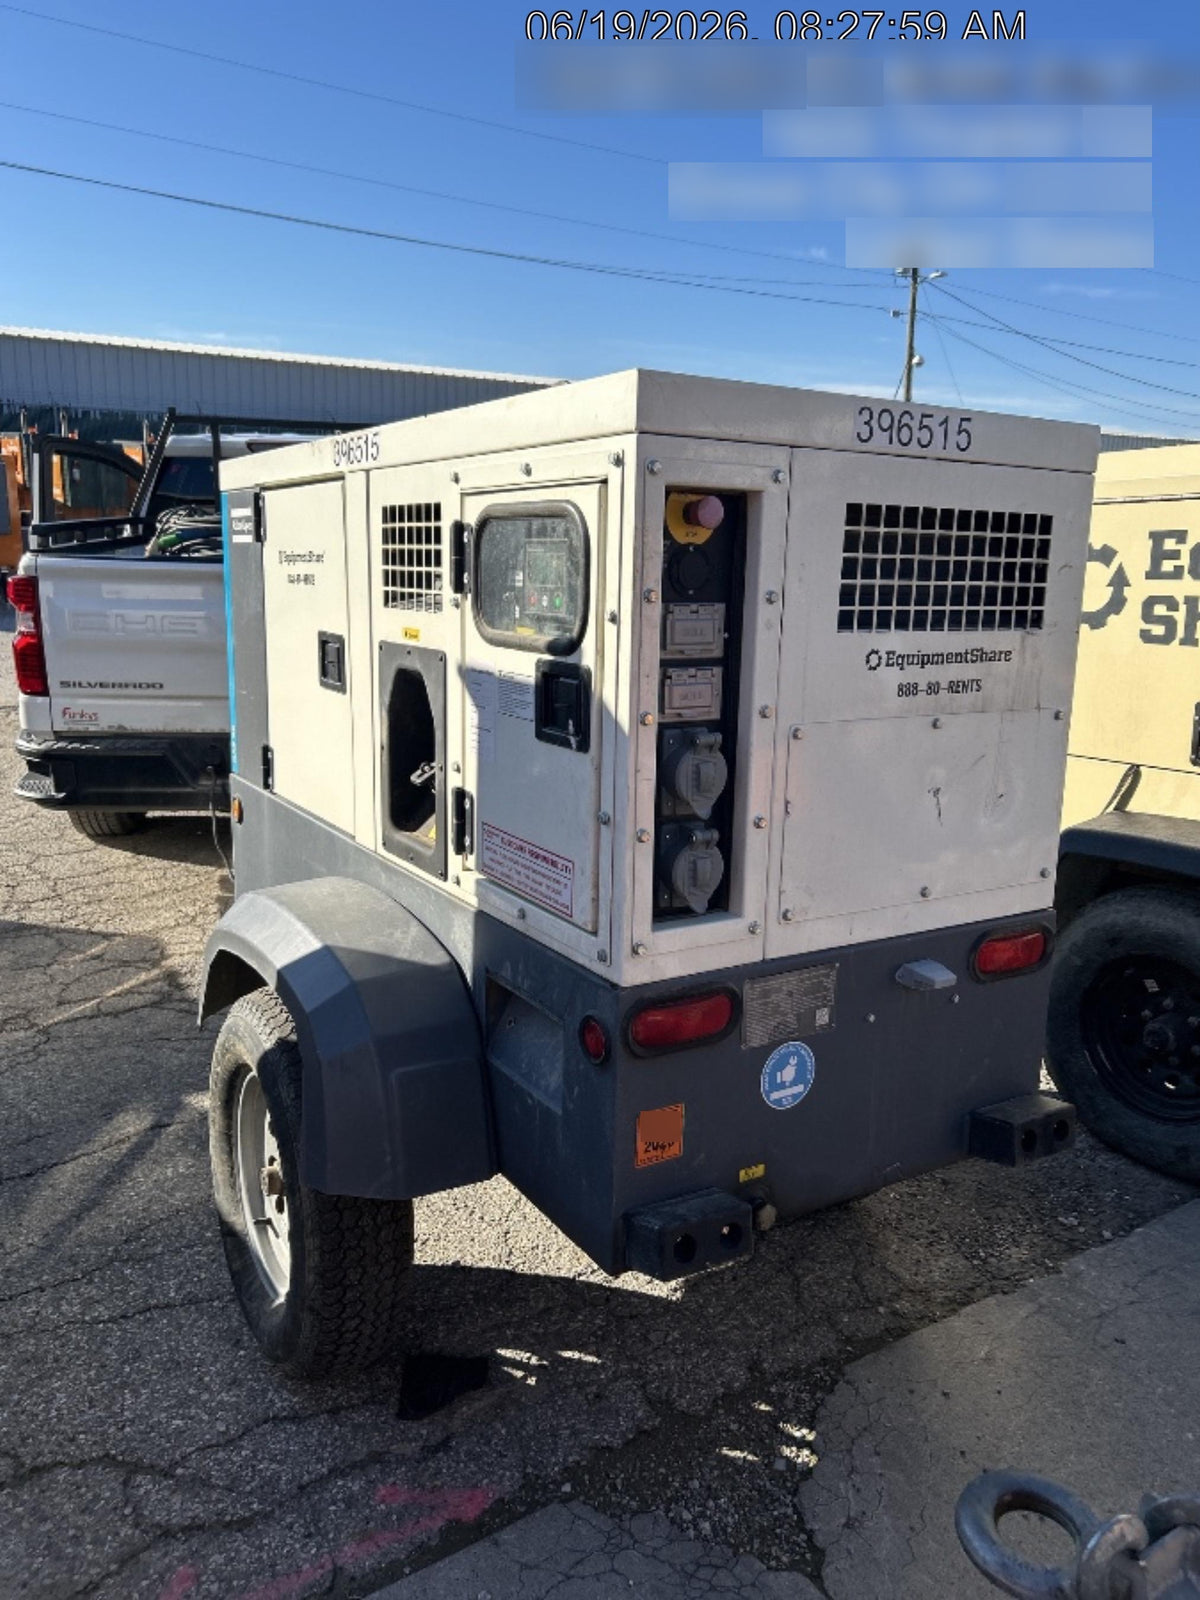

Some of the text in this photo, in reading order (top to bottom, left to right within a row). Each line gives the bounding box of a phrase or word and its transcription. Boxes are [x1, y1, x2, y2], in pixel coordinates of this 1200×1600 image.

[856, 405, 974, 453] 396515
[333, 432, 380, 467] 396515
[885, 647, 1013, 671] EquipmentShare
[59, 680, 165, 690] SILVERADO
[897, 678, 983, 698] 888-80-RENTS
